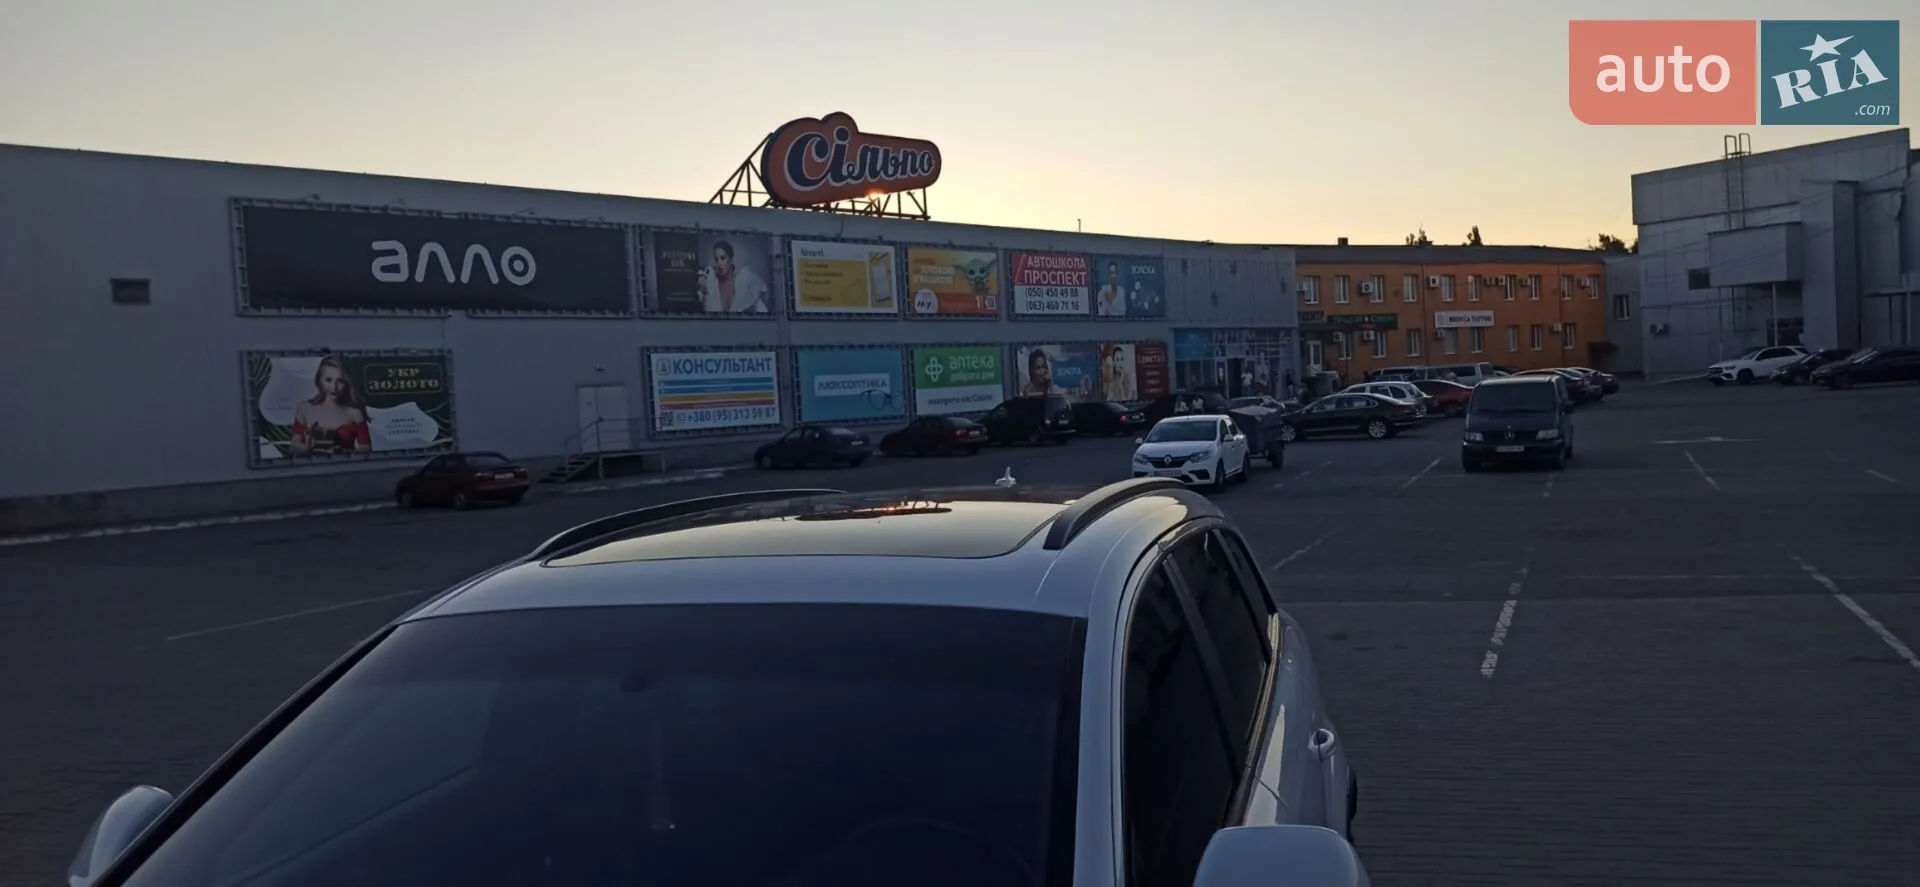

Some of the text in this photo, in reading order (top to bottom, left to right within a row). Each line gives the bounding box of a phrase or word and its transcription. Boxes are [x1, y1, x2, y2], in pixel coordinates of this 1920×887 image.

[784, 125, 935, 191] Сільпо
[1027, 255, 1086, 269] АВТОШКОЛА
[1023, 270, 1087, 285] ПРОСПЕКТ
[1025, 287, 1043, 299] (050)
[1045, 287, 1058, 297] 450
[1060, 288, 1068, 298] 49
[1026, 299, 1045, 312] (063)
[1046, 301, 1059, 311] 460
[673, 358, 772, 374] КОНСУЛЬТАНТ
[949, 355, 994, 370] аптека
[387, 367, 420, 378] УКР
[368, 378, 440, 391] ЗОЛОТО
